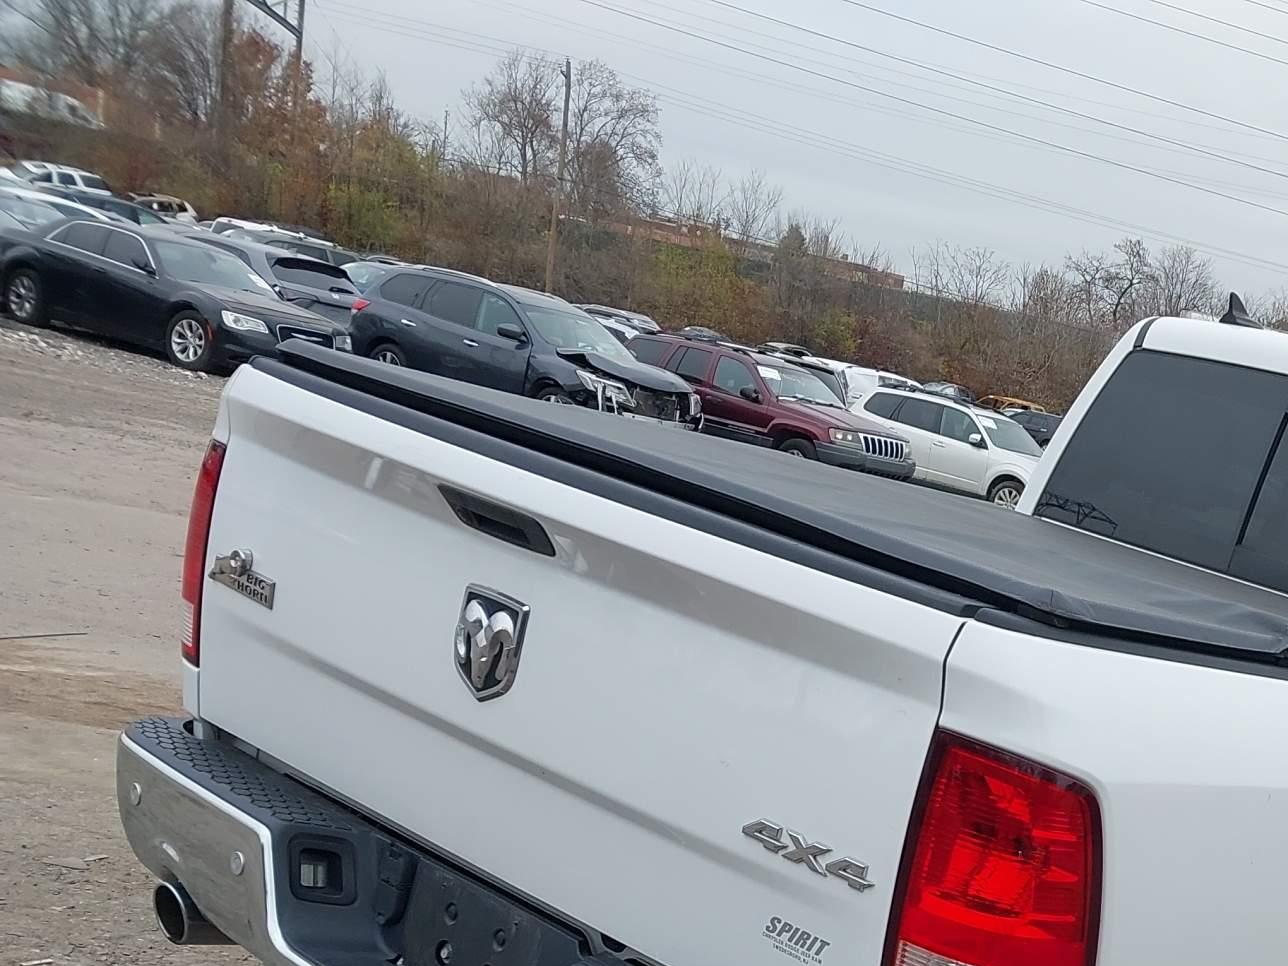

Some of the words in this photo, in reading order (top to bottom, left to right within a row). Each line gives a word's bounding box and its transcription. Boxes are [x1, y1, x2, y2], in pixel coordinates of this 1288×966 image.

[236, 580, 268, 604] HORN
[246, 573, 266, 590] BIG
[765, 916, 831, 957] SPIRIT
